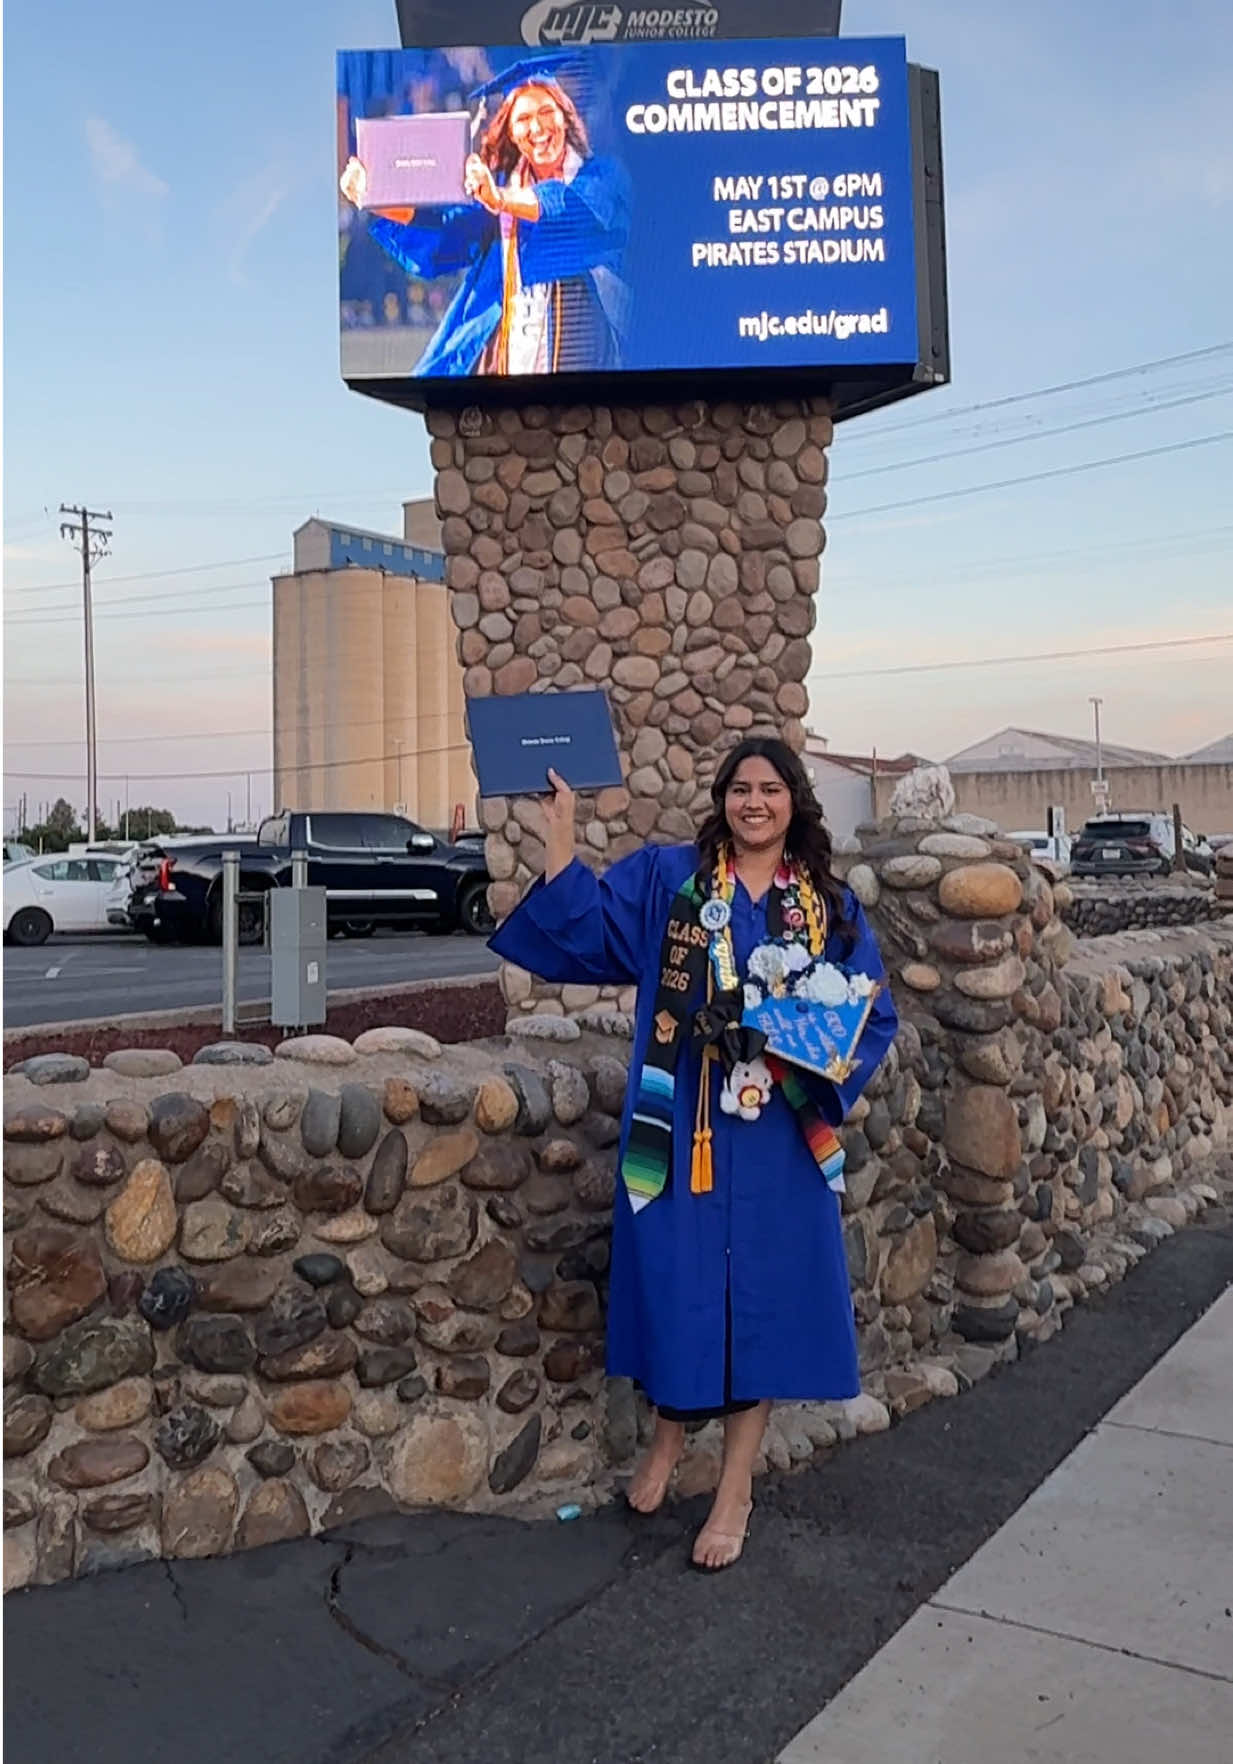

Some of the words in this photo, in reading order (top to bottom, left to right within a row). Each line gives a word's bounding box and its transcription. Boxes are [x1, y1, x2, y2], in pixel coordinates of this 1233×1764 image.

[624, 27, 665, 38] JUNIOR
[668, 25, 716, 37] COLLEGE
[627, 9, 719, 27] MODESTO
[667, 68, 758, 98] CLASS
[761, 67, 801, 96] OF
[805, 65, 879, 95] 2026
[625, 98, 880, 133] COMMENCEMENT
[713, 175, 763, 201] MAY
[767, 174, 807, 200] 1ST
[809, 176, 829, 201] @
[832, 172, 882, 197] 6PM
[729, 208, 785, 233] EAST
[786, 205, 884, 231] CAMPUS
[692, 241, 780, 267] PIRATES
[783, 238, 885, 264] STADIUM
[738, 307, 889, 341] mjc.edu/grad
[667, 919, 709, 949] CLASS
[669, 945, 689, 966] OF
